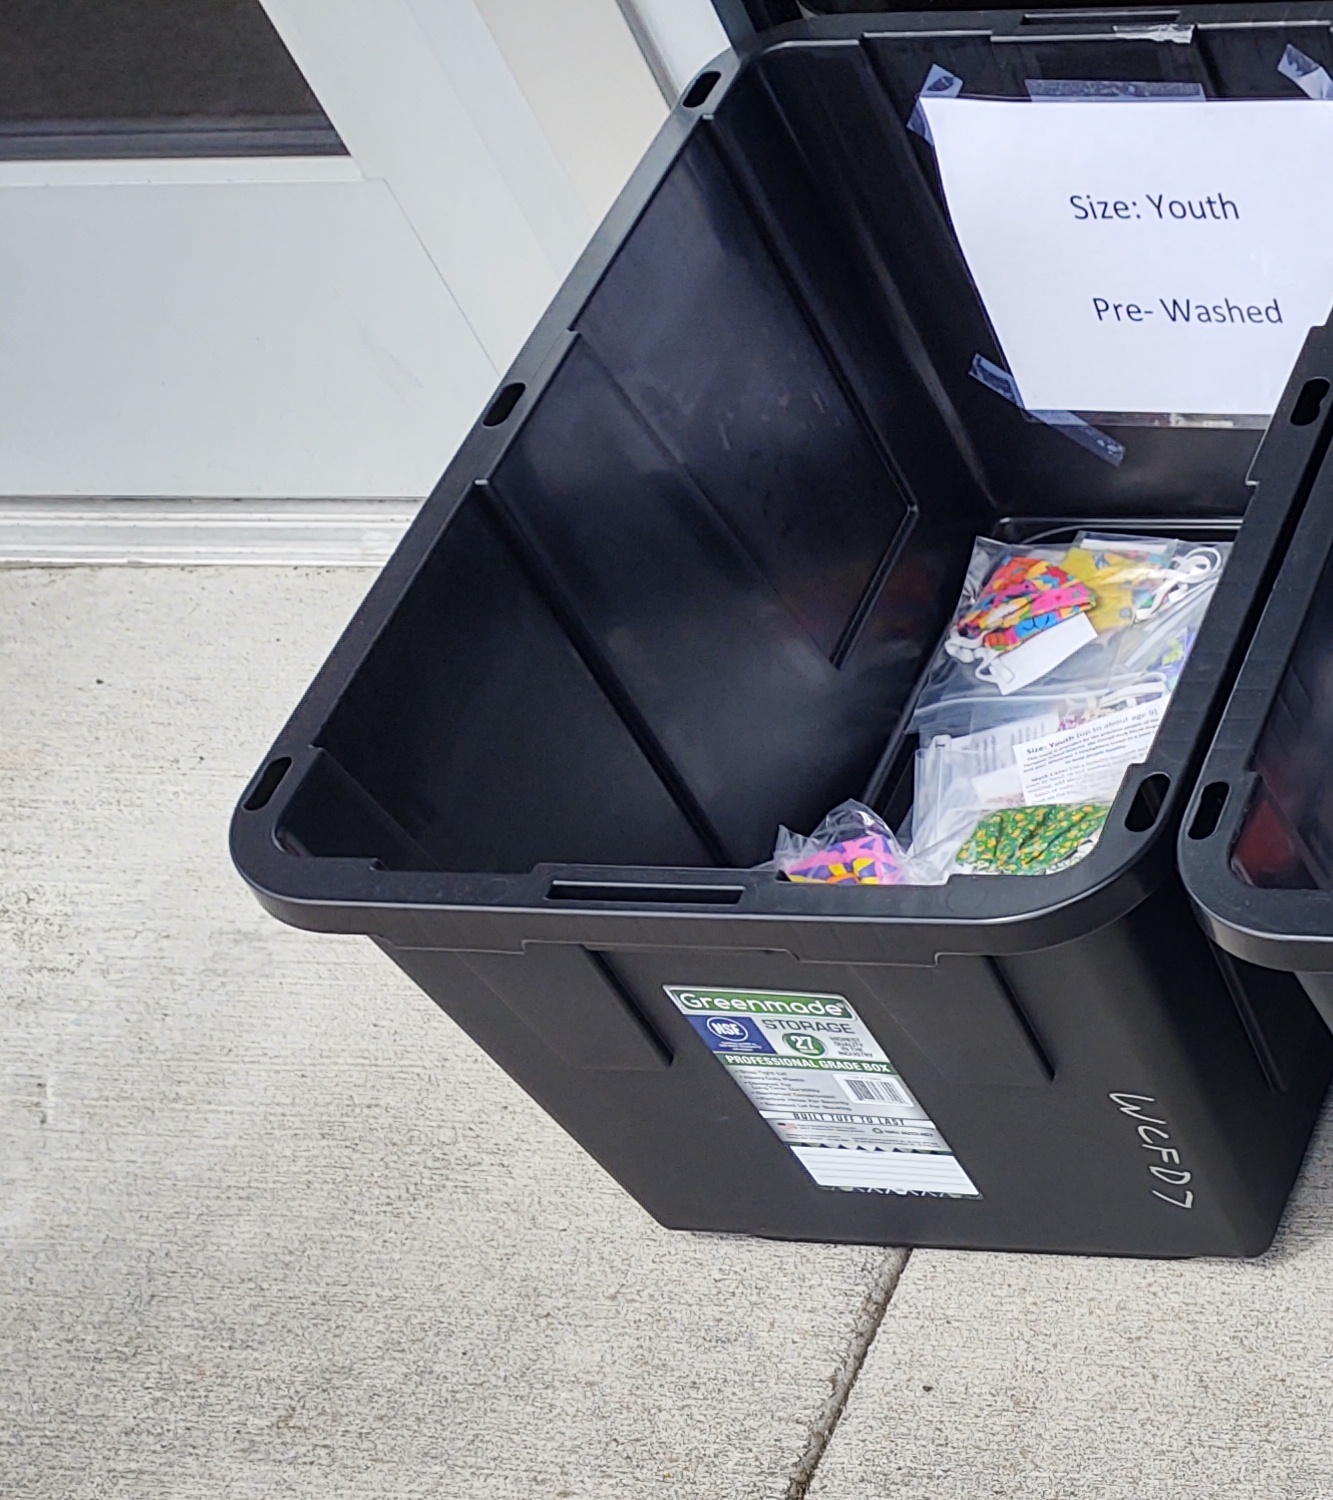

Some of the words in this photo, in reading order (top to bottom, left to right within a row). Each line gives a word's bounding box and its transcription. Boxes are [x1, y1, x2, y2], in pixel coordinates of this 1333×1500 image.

[1069, 194, 1141, 219] Size:
[1146, 192, 1240, 219] Youth
[1092, 297, 1154, 322] Pre-
[1159, 297, 1283, 323] Washed
[1048, 735, 1075, 748] Youth
[679, 992, 843, 1016] Greenmade
[711, 1022, 743, 1036] NSF
[761, 1019, 856, 1034] STORAGE
[790, 1036, 815, 1050] 27
[725, 1055, 819, 1068] PROFESSIONAL
[819, 1061, 862, 1071] GRADE
[863, 1064, 891, 1073] BOX
[793, 1112, 825, 1121] BUILT
[827, 1114, 855, 1122] TUFF
[859, 1116, 874, 1124] TO
[878, 1118, 906, 1126] LAST
